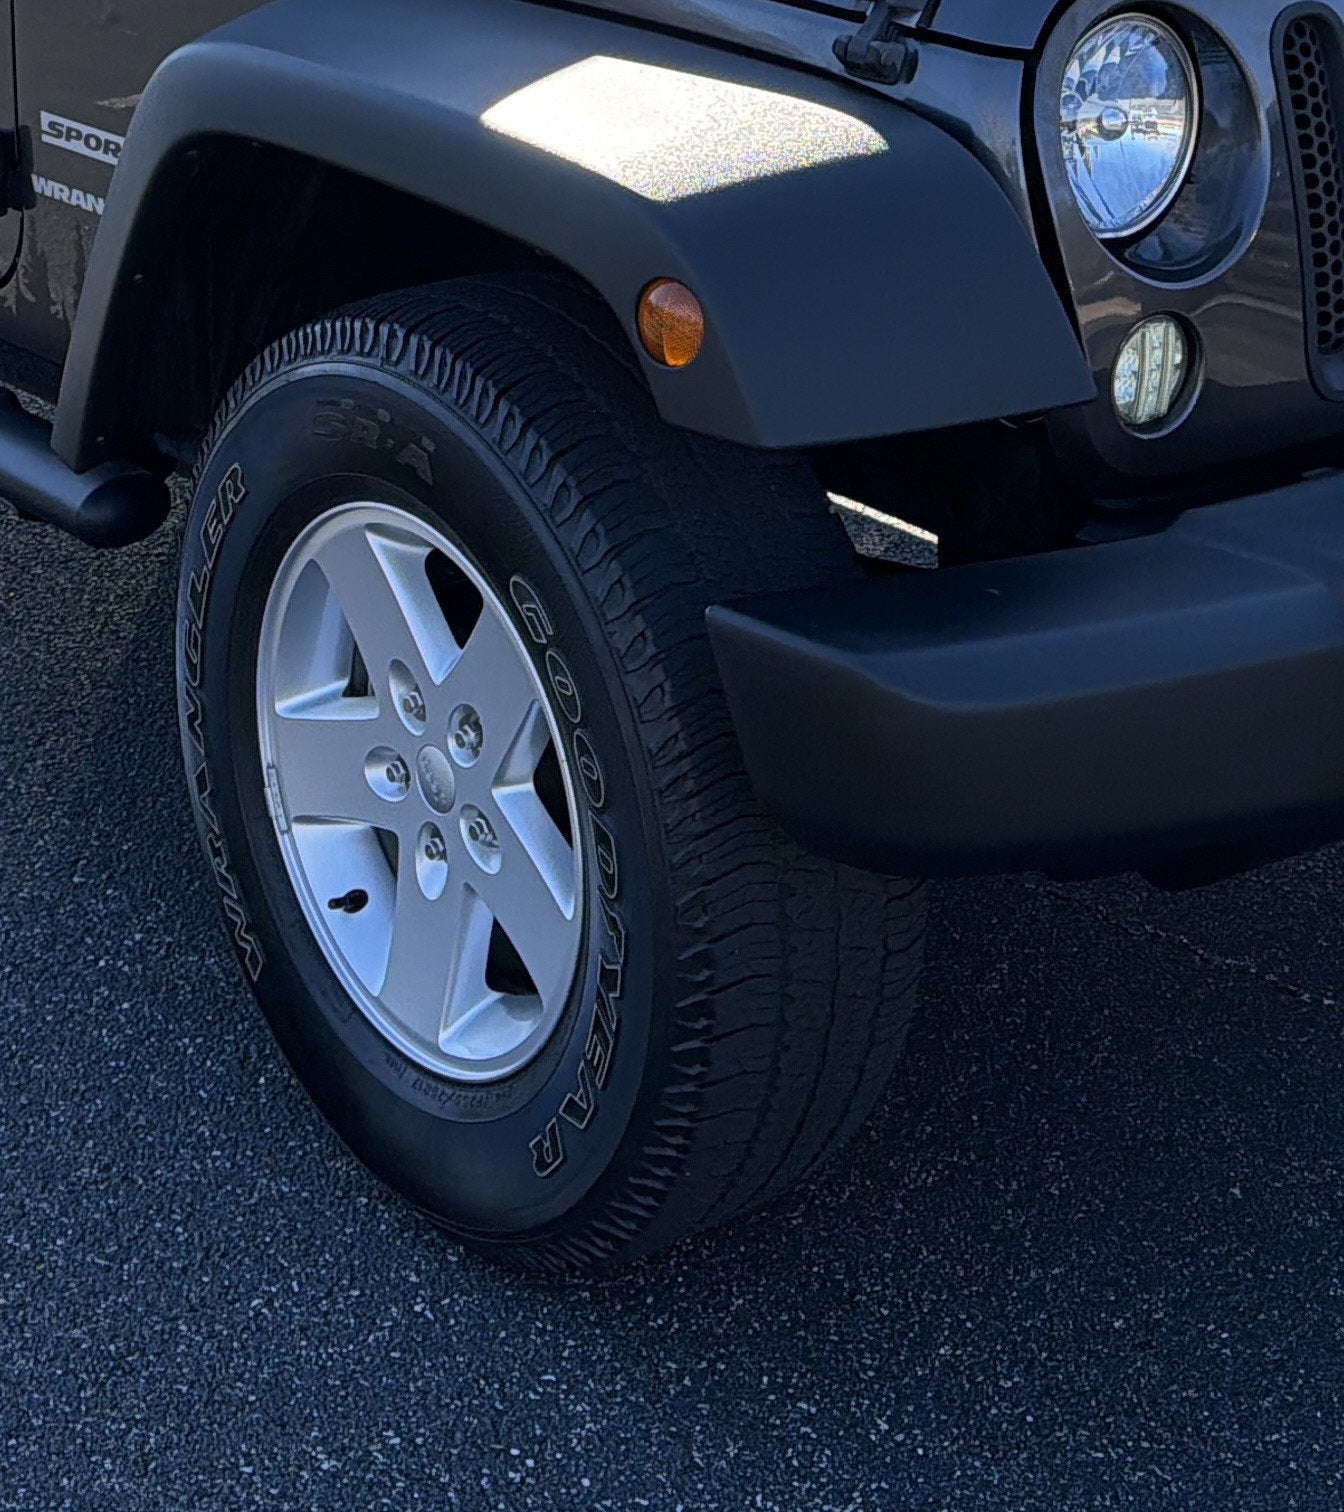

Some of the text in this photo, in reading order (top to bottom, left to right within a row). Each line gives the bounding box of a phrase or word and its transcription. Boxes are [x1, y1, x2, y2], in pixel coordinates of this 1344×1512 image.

[31, 173, 106, 216] WRAN
[41, 120, 123, 159] SPOR
[184, 461, 265, 984] WRANGLER
[509, 573, 627, 1178] GOODYEAR
